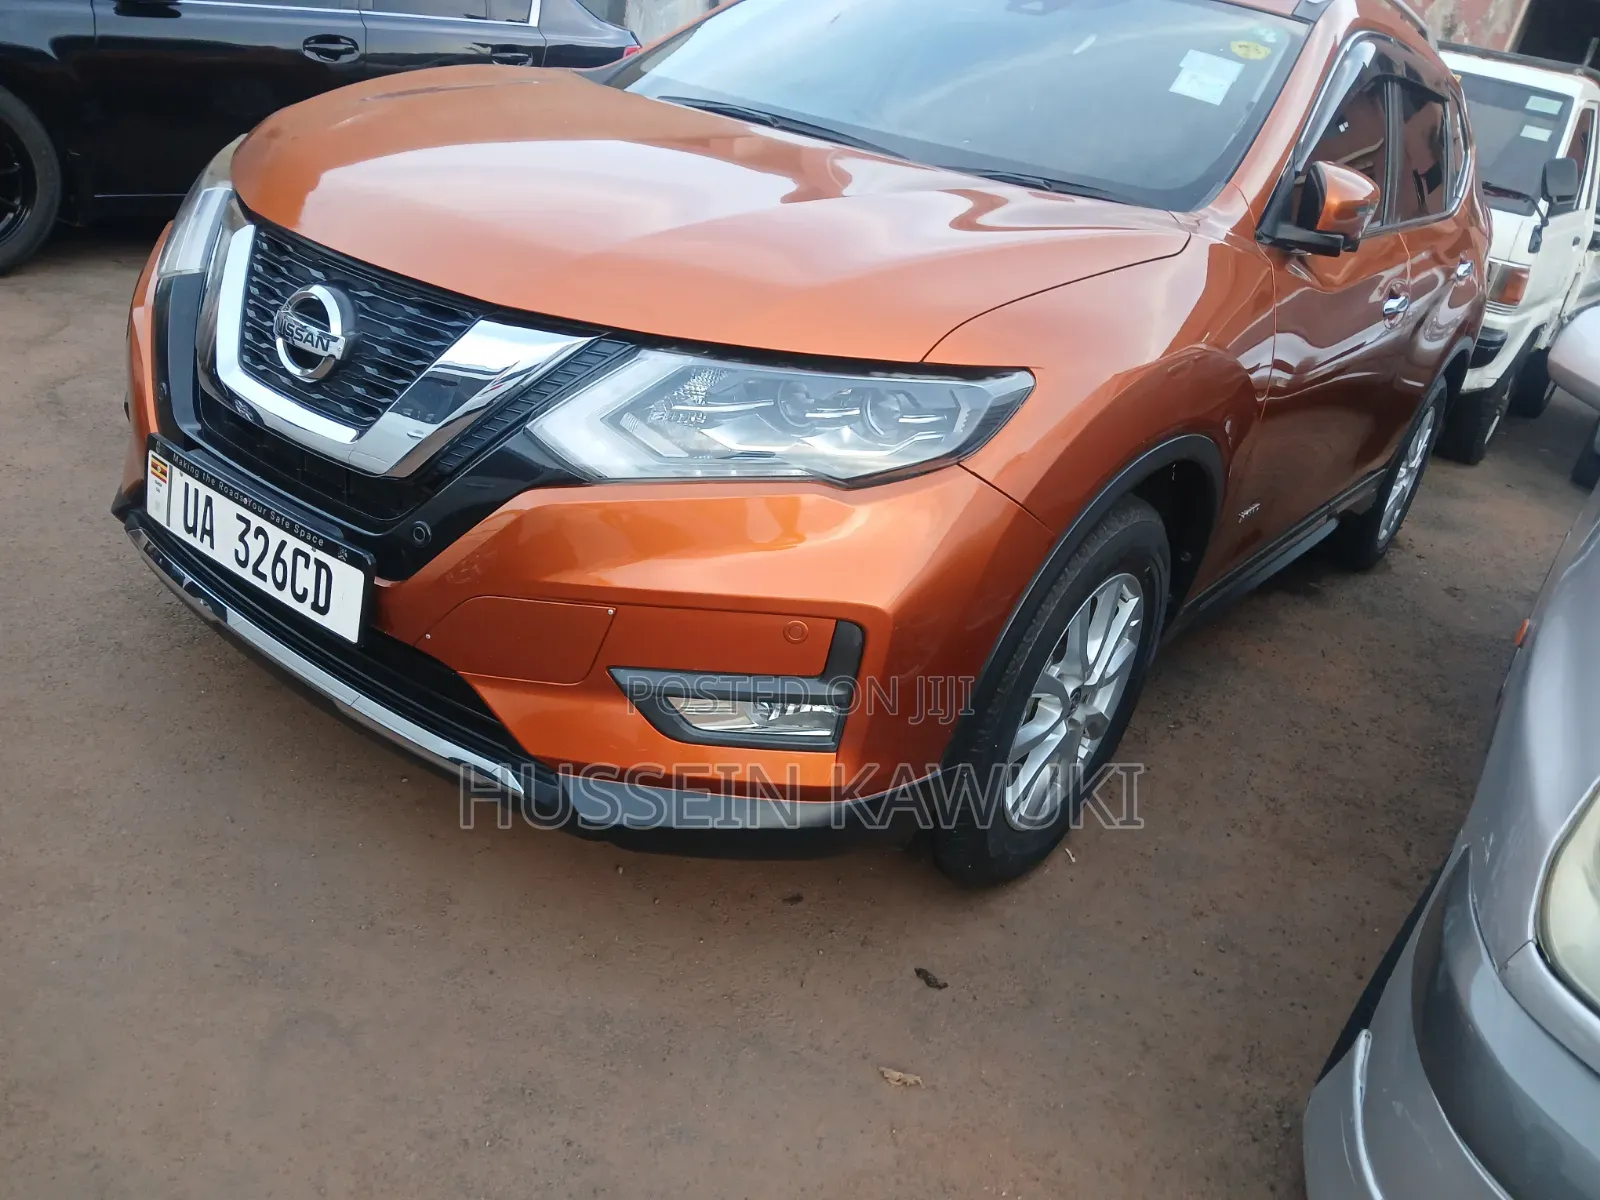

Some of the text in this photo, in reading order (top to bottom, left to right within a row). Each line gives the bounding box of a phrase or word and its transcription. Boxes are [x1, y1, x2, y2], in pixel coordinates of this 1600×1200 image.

[277, 313, 331, 352] NISSAN
[172, 453, 200, 478] Making
[202, 472, 216, 486] the
[269, 510, 290, 529] Safe
[293, 524, 324, 547] Space
[183, 481, 333, 616] UA 326CD
